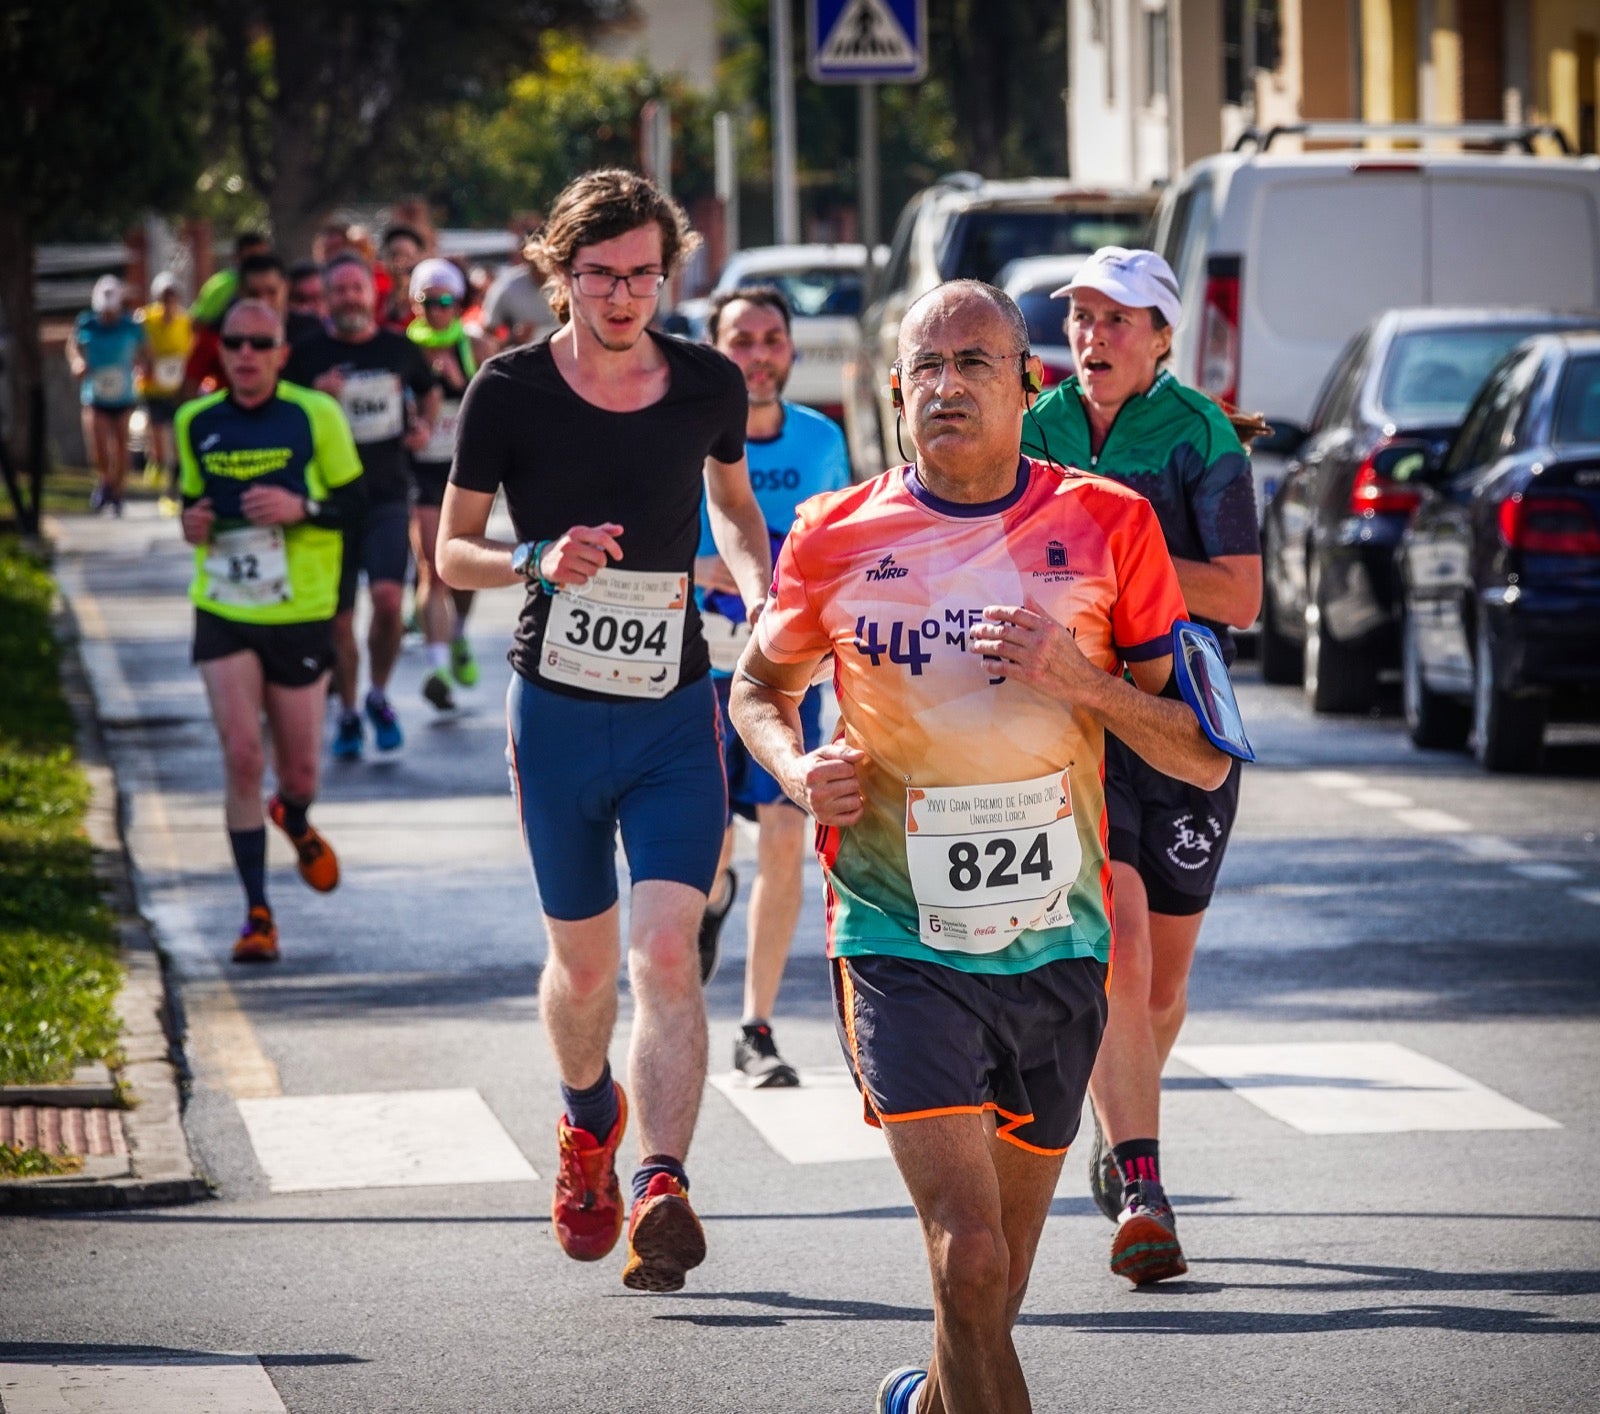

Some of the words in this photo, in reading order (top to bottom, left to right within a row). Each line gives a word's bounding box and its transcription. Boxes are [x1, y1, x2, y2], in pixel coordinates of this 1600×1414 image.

[865, 567, 909, 582] TMRG
[566, 608, 668, 656] 3094
[948, 832, 1053, 892] 824
